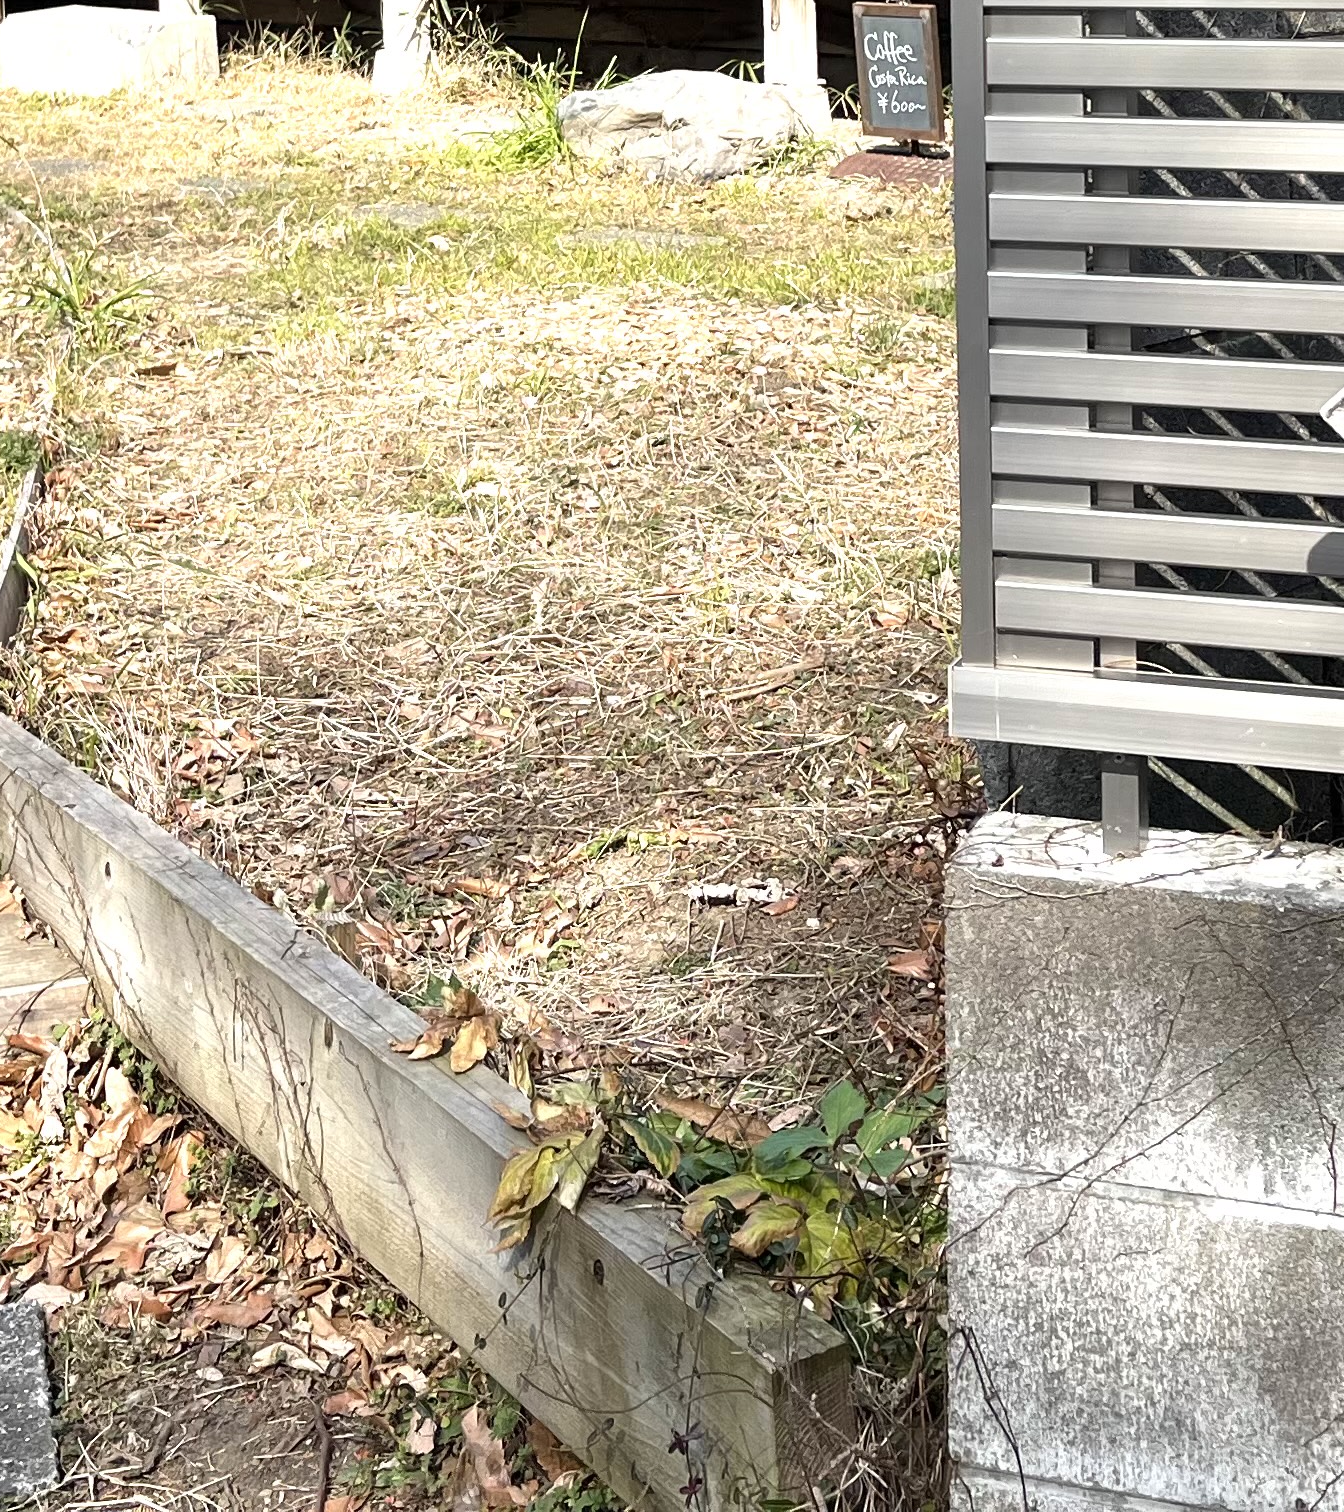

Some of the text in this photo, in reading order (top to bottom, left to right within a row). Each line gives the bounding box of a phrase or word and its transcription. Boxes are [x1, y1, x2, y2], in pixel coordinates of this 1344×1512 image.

[863, 31, 917, 64] Coffee
[868, 64, 928, 88] Costa Rica
